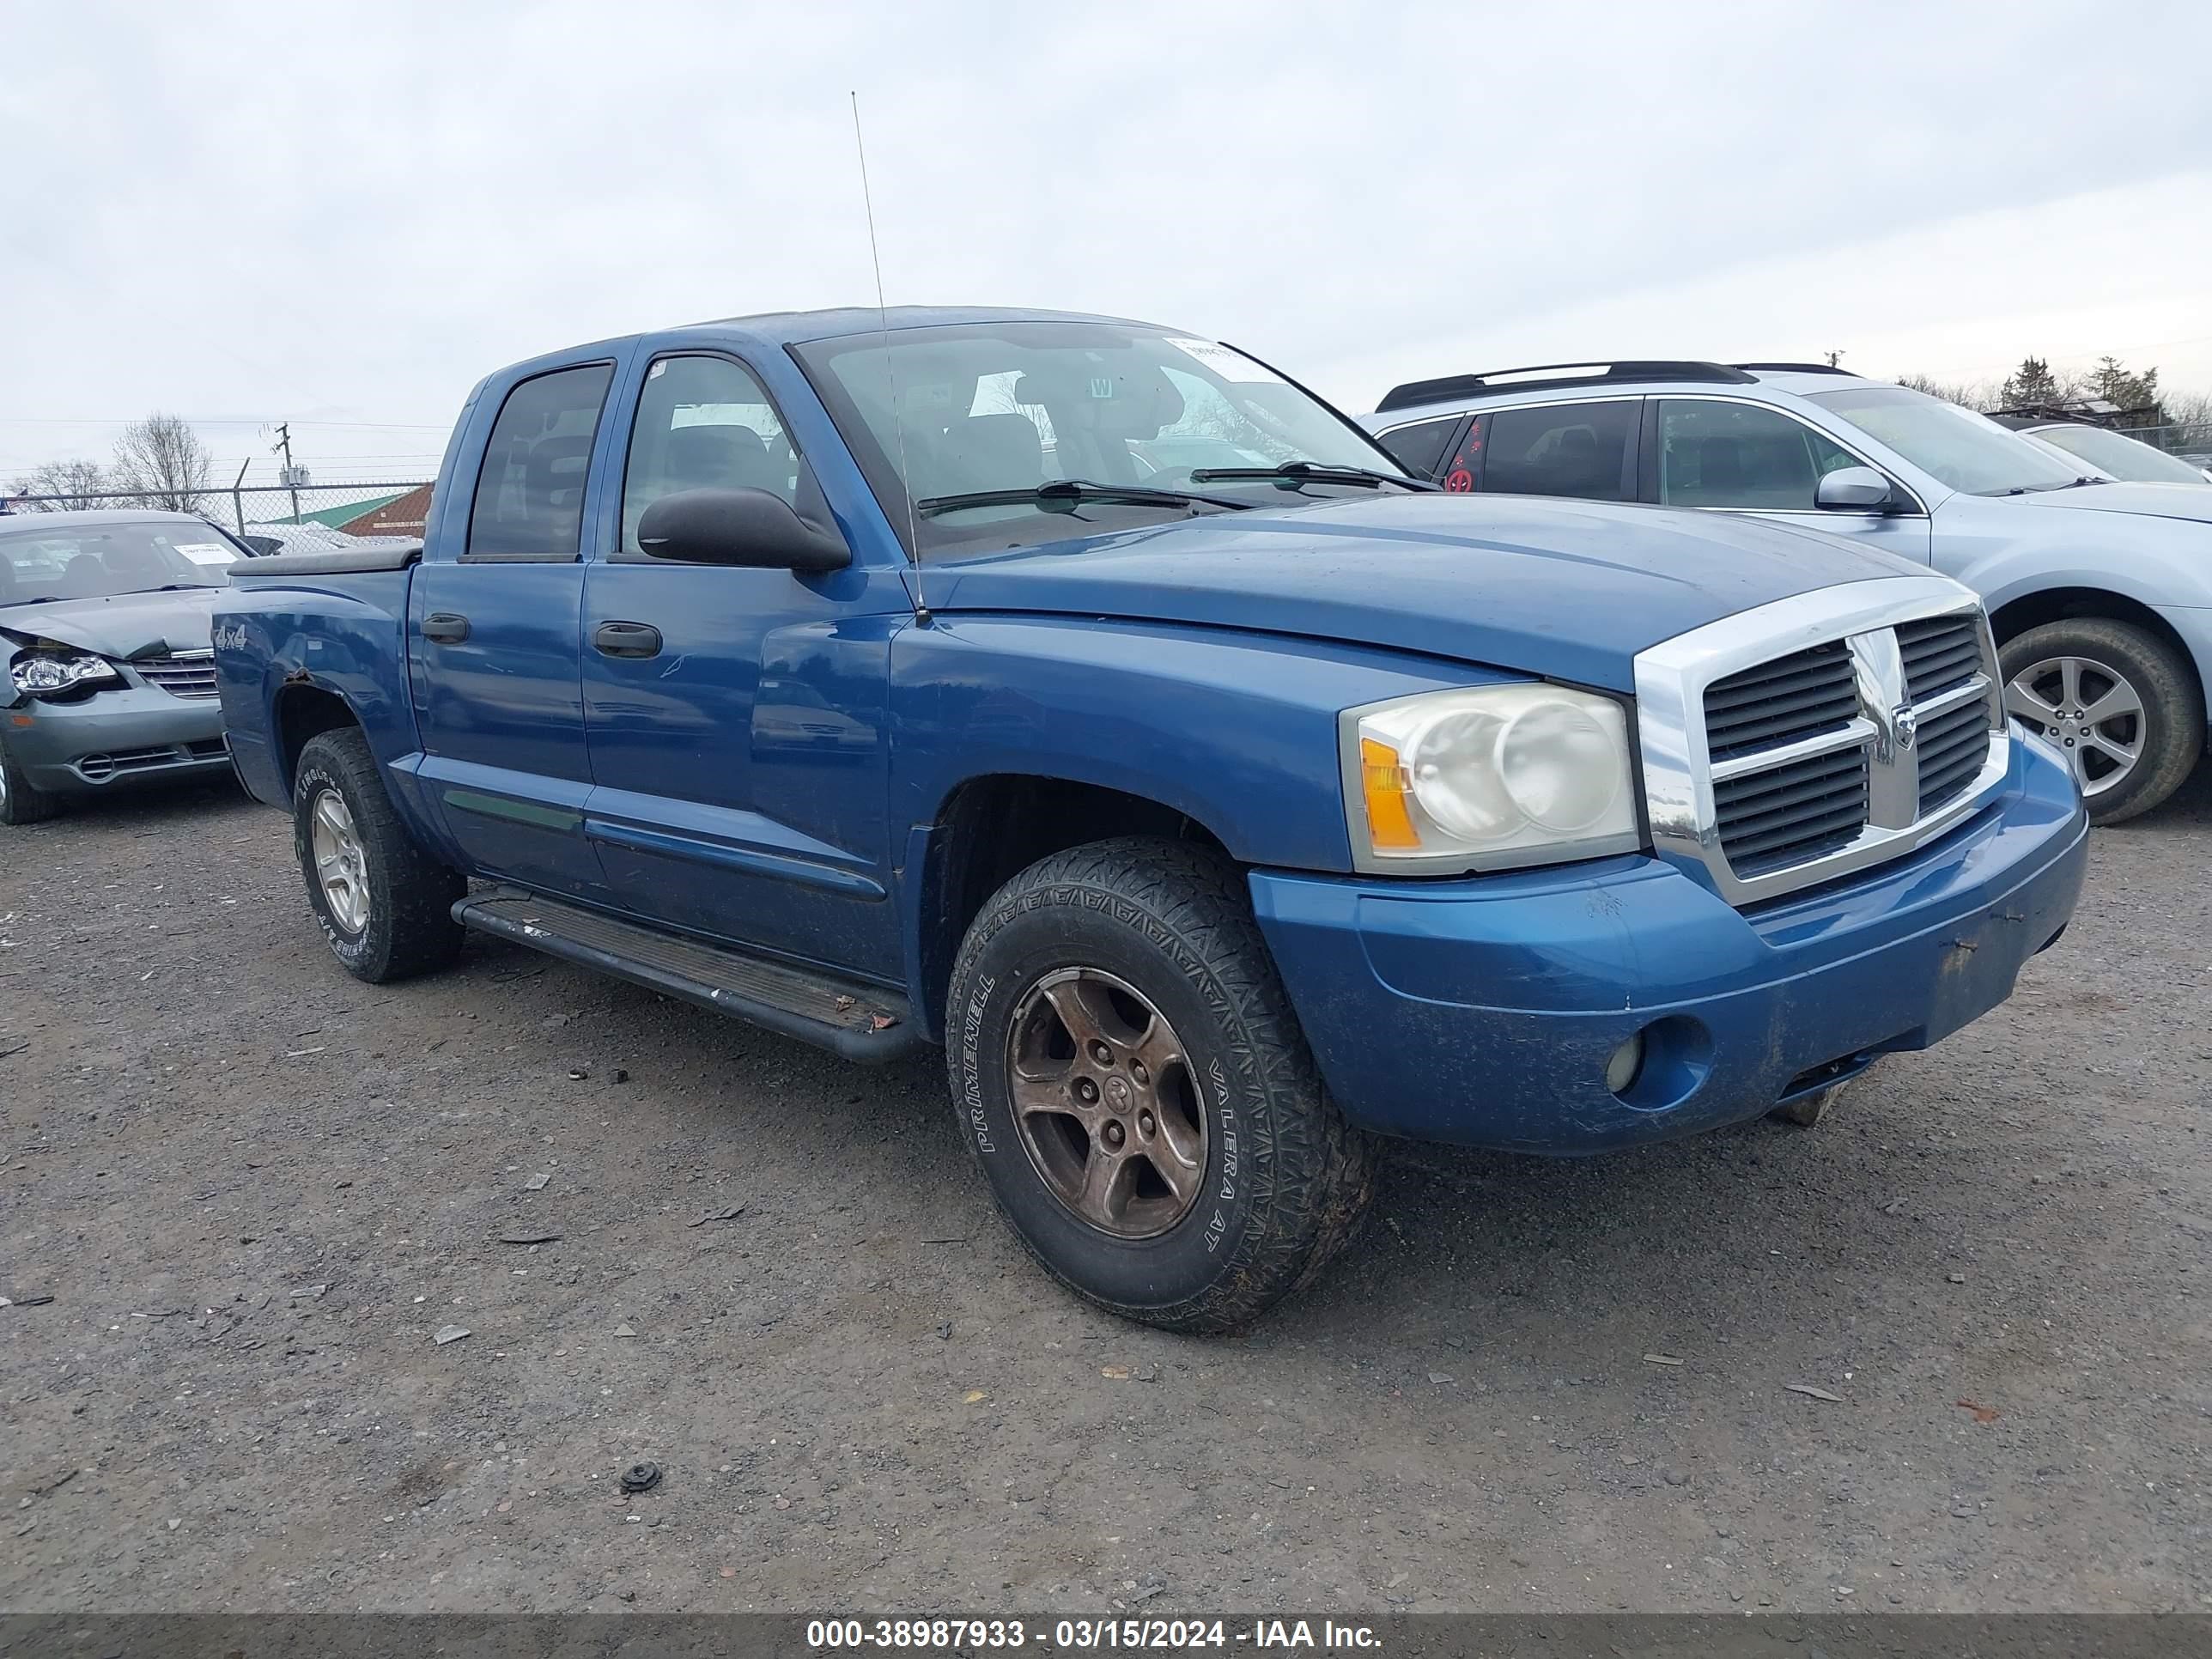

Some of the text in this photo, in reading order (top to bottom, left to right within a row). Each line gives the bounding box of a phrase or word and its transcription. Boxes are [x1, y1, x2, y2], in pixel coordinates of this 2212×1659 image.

[963, 974, 996, 1152] PRIMEWELL
[1204, 1057, 1237, 1253] VALERA AT
